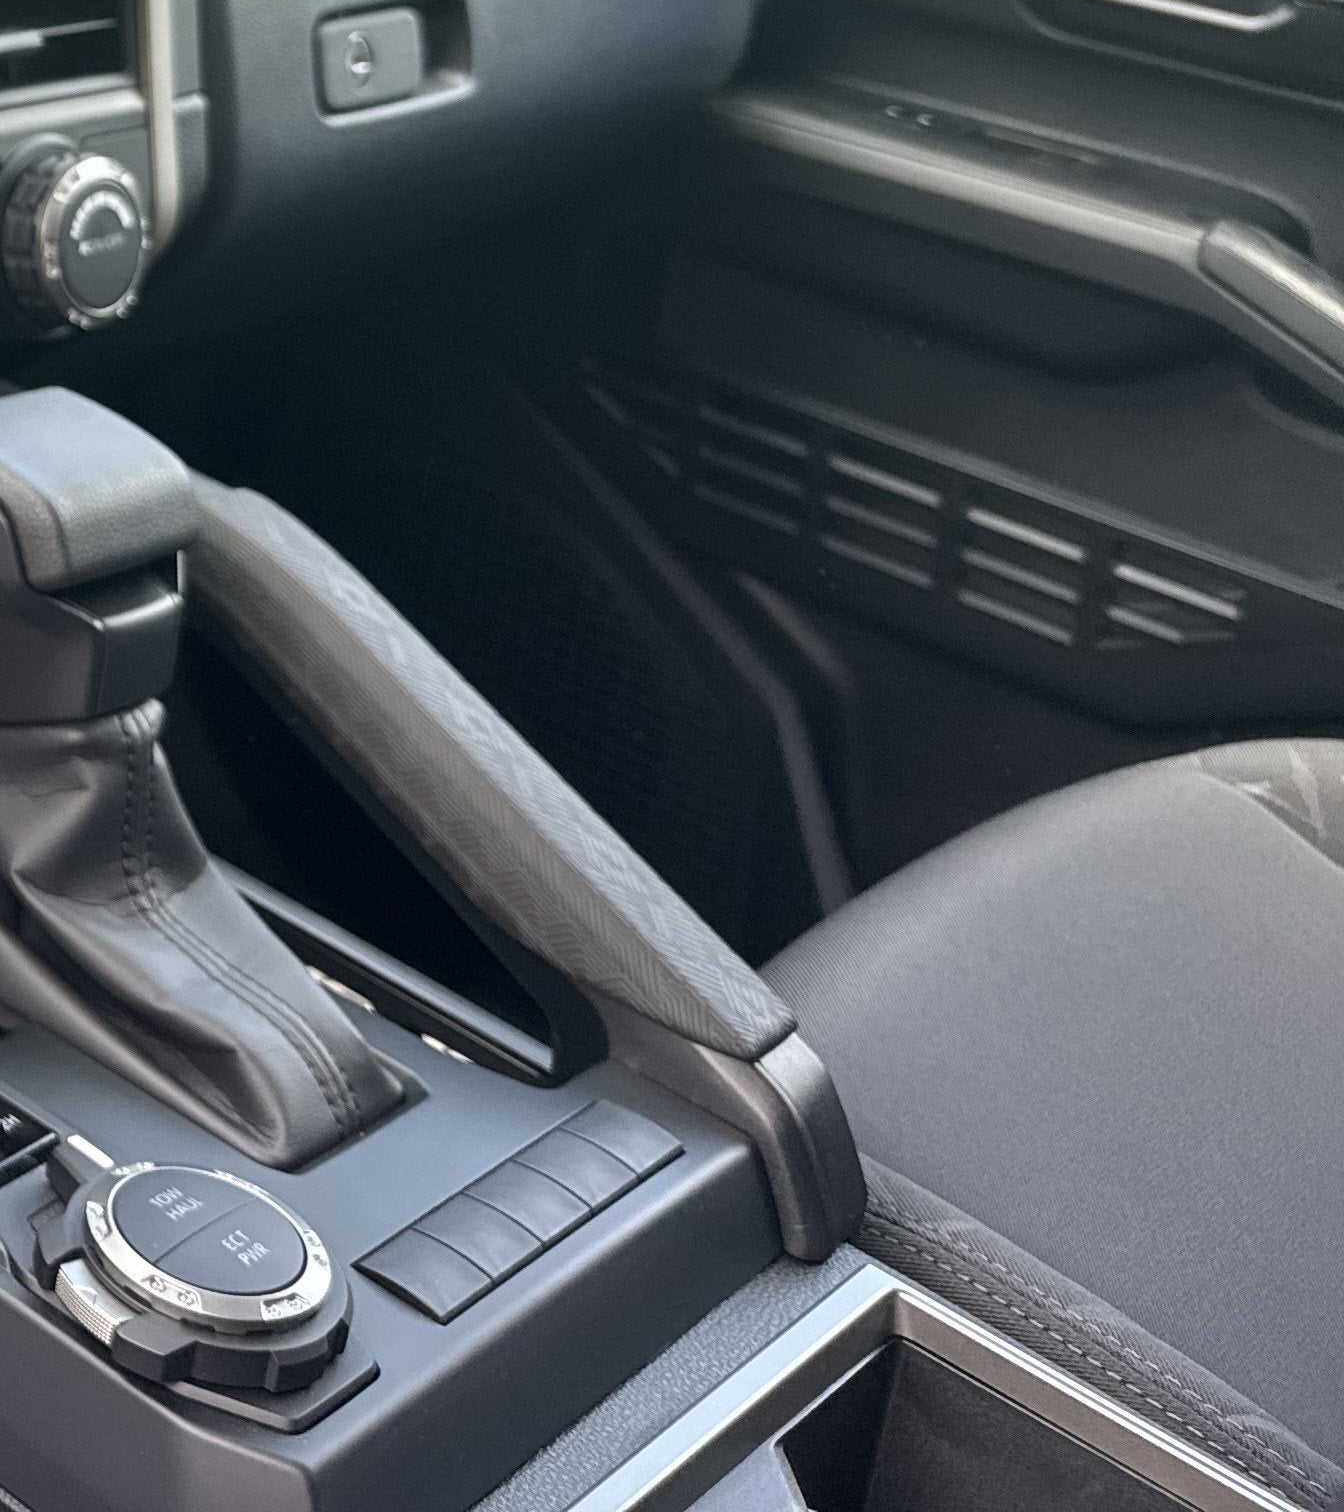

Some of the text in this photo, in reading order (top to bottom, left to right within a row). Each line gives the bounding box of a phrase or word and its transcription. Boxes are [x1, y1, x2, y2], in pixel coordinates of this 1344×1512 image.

[148, 1185, 184, 1208] TOW
[164, 1196, 205, 1223] HAUL
[220, 1228, 251, 1253] ECT
[237, 1241, 271, 1267] PWR
